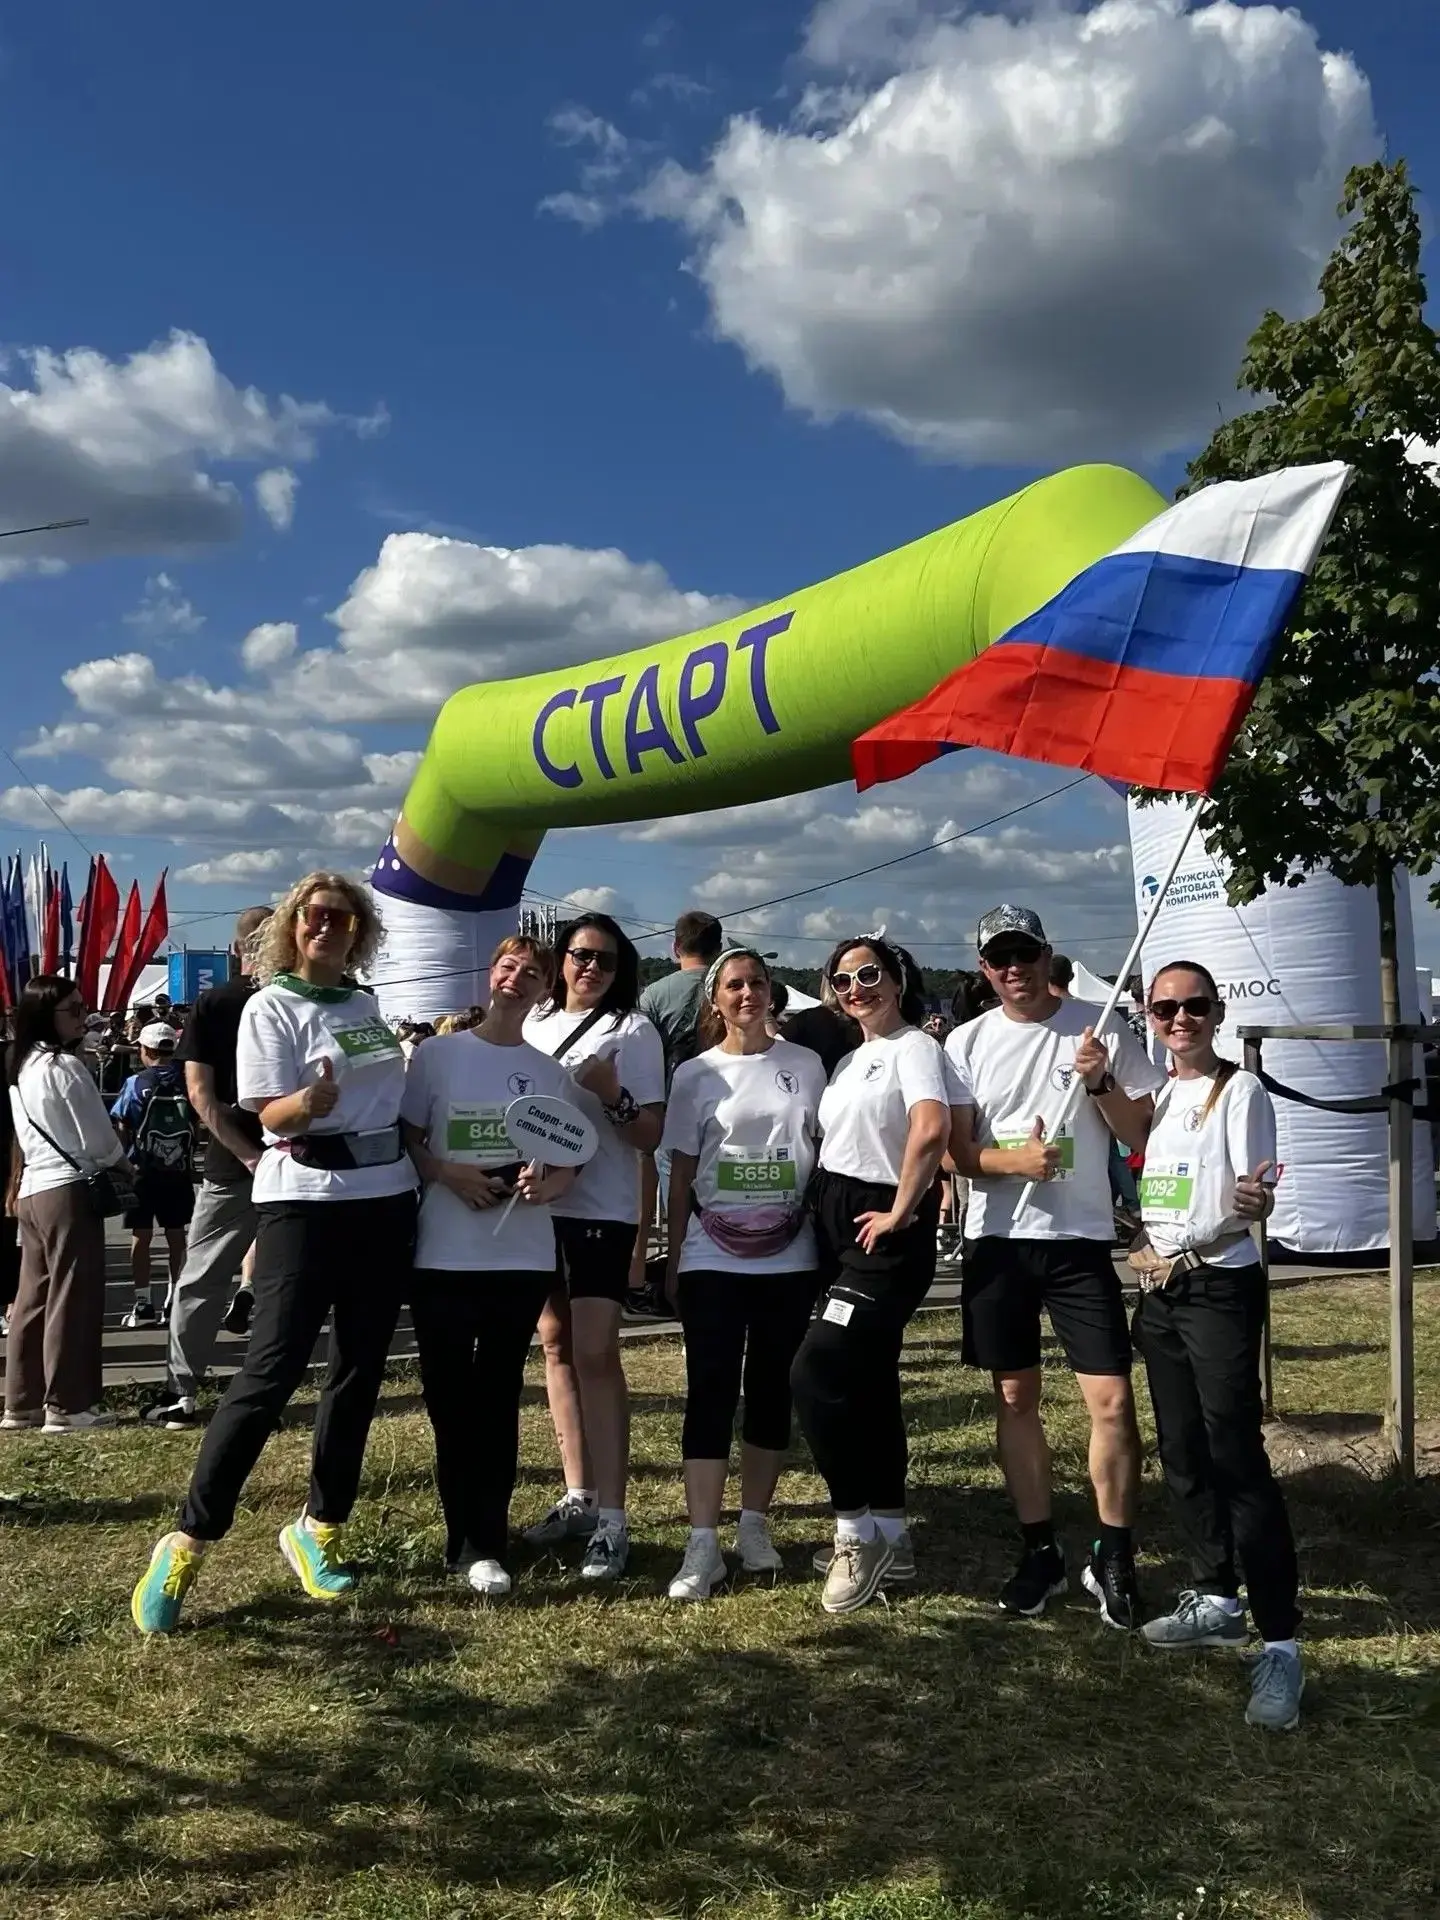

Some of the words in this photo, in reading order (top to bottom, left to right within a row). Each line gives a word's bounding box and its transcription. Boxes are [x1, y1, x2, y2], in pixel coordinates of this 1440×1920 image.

[533, 609, 796, 788] СТАРТ
[1170, 869, 1225, 885] АЛУЖСКАЯ
[1165, 880, 1216, 897] СБЫТОВАЯ
[1166, 891, 1219, 907] КОМПАНИЯ
[1216, 978, 1282, 1000] СМОС
[346, 1028, 390, 1046] 5062
[516, 1118, 547, 1137] стиль
[548, 1132, 583, 1153] жизни!
[563, 1121, 585, 1137] наш
[733, 1165, 781, 1181] 5658
[1145, 1179, 1178, 1197] 1092
